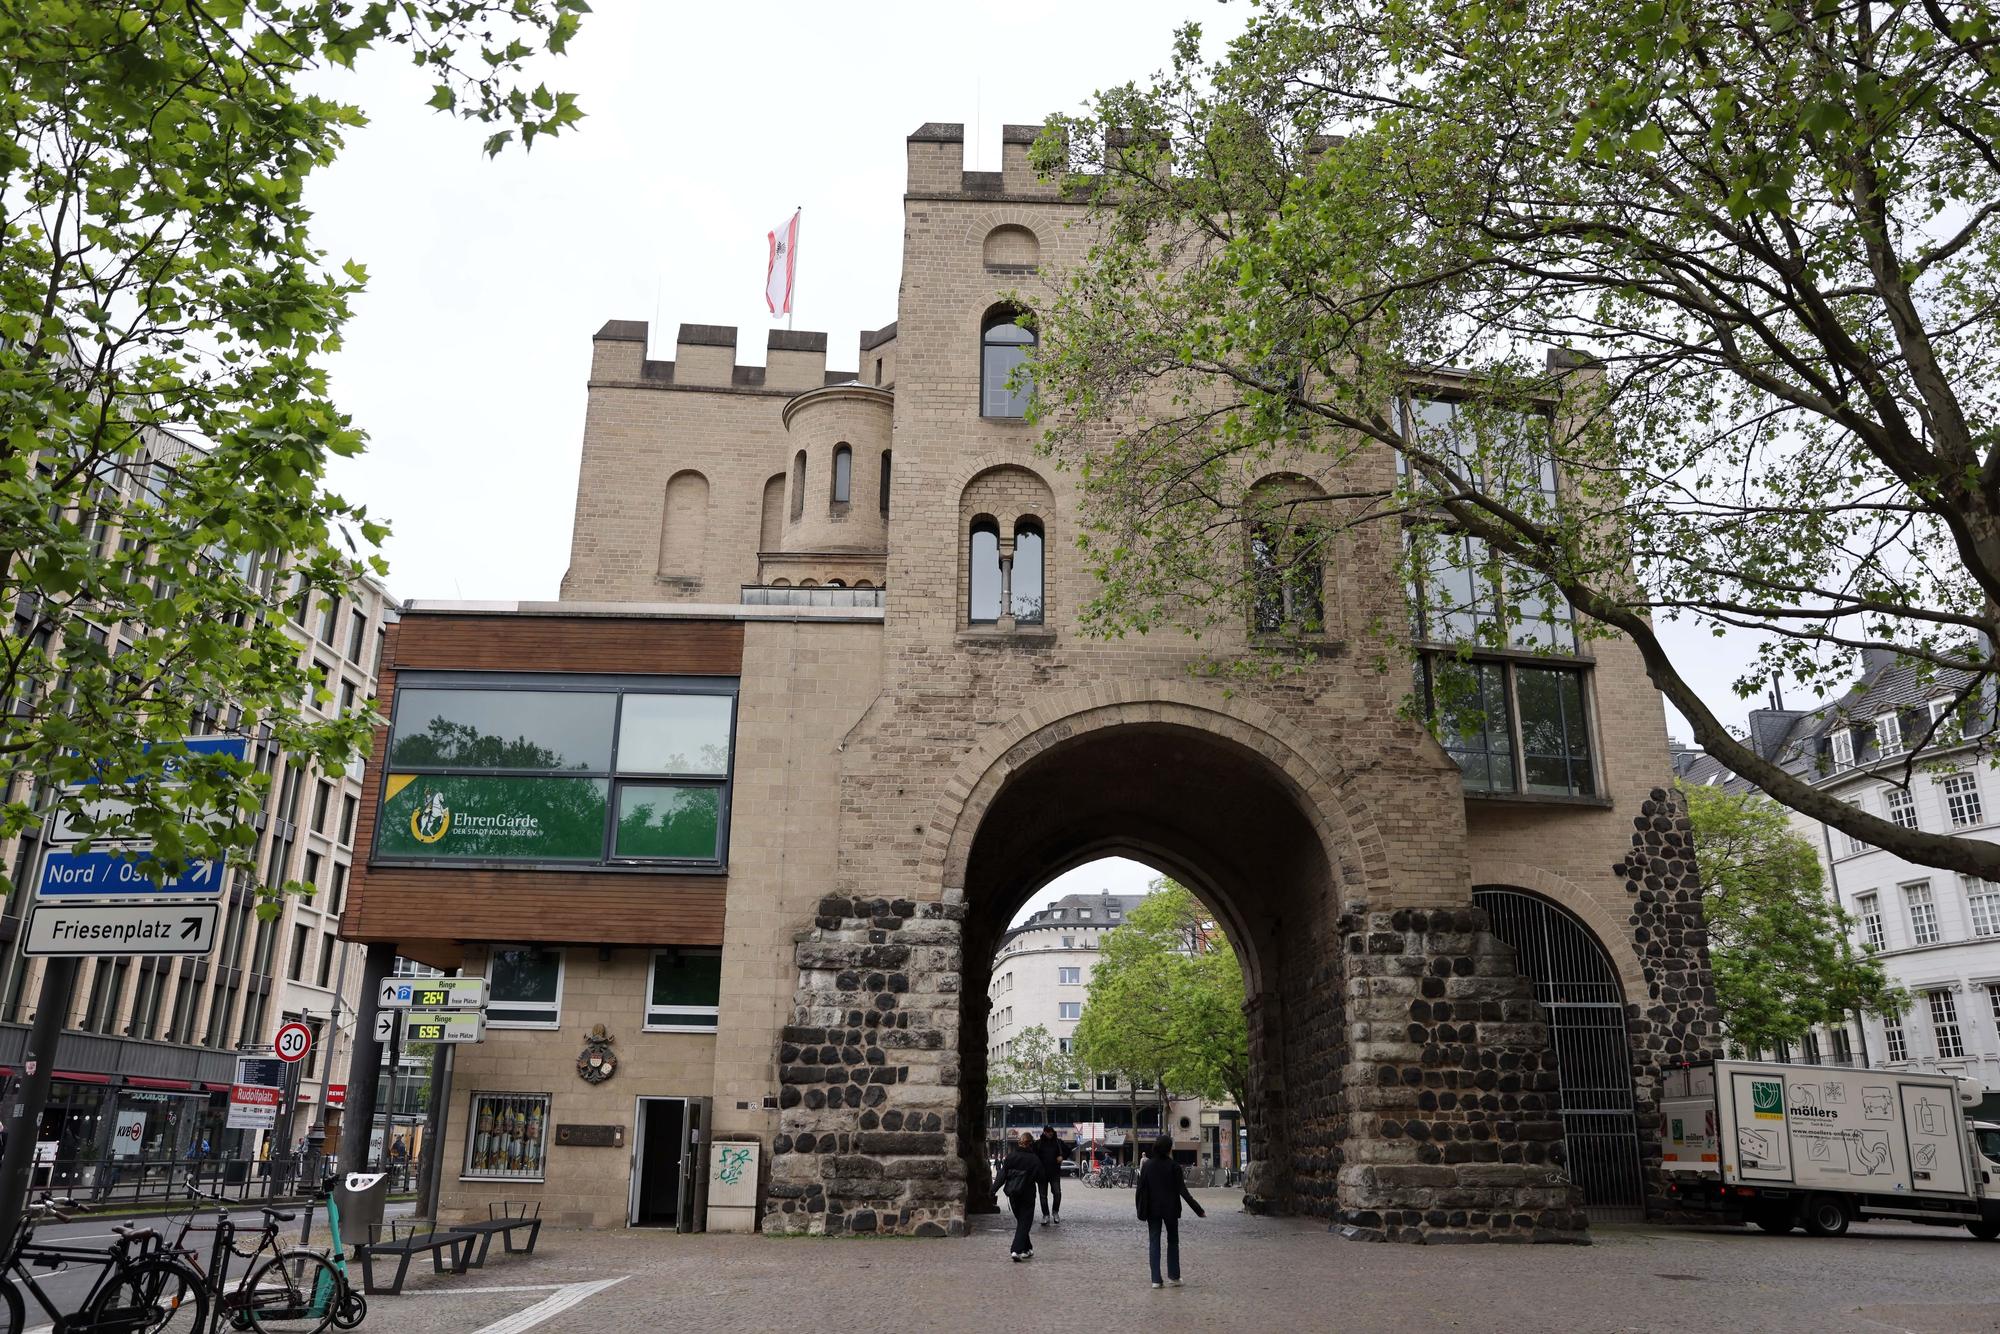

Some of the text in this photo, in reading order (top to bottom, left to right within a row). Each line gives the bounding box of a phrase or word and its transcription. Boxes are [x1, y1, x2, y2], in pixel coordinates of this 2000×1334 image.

[454, 812, 538, 828] EhrenGarde
[467, 828, 488, 836] STADT
[489, 828, 508, 836] KÖLN
[510, 829, 525, 837] 1902
[49, 863, 96, 883] Nord
[52, 920, 171, 944] Friesenplatz
[438, 981, 457, 990] Ringe
[422, 991, 444, 1005] 264
[434, 1015, 452, 1024] Ringe
[418, 1025, 440, 1039] 695
[281, 1033, 303, 1051] 30
[237, 1087, 273, 1104] Rudolfplatz
[1790, 1105, 1838, 1118] möllers
[116, 1125, 132, 1137] KVB
